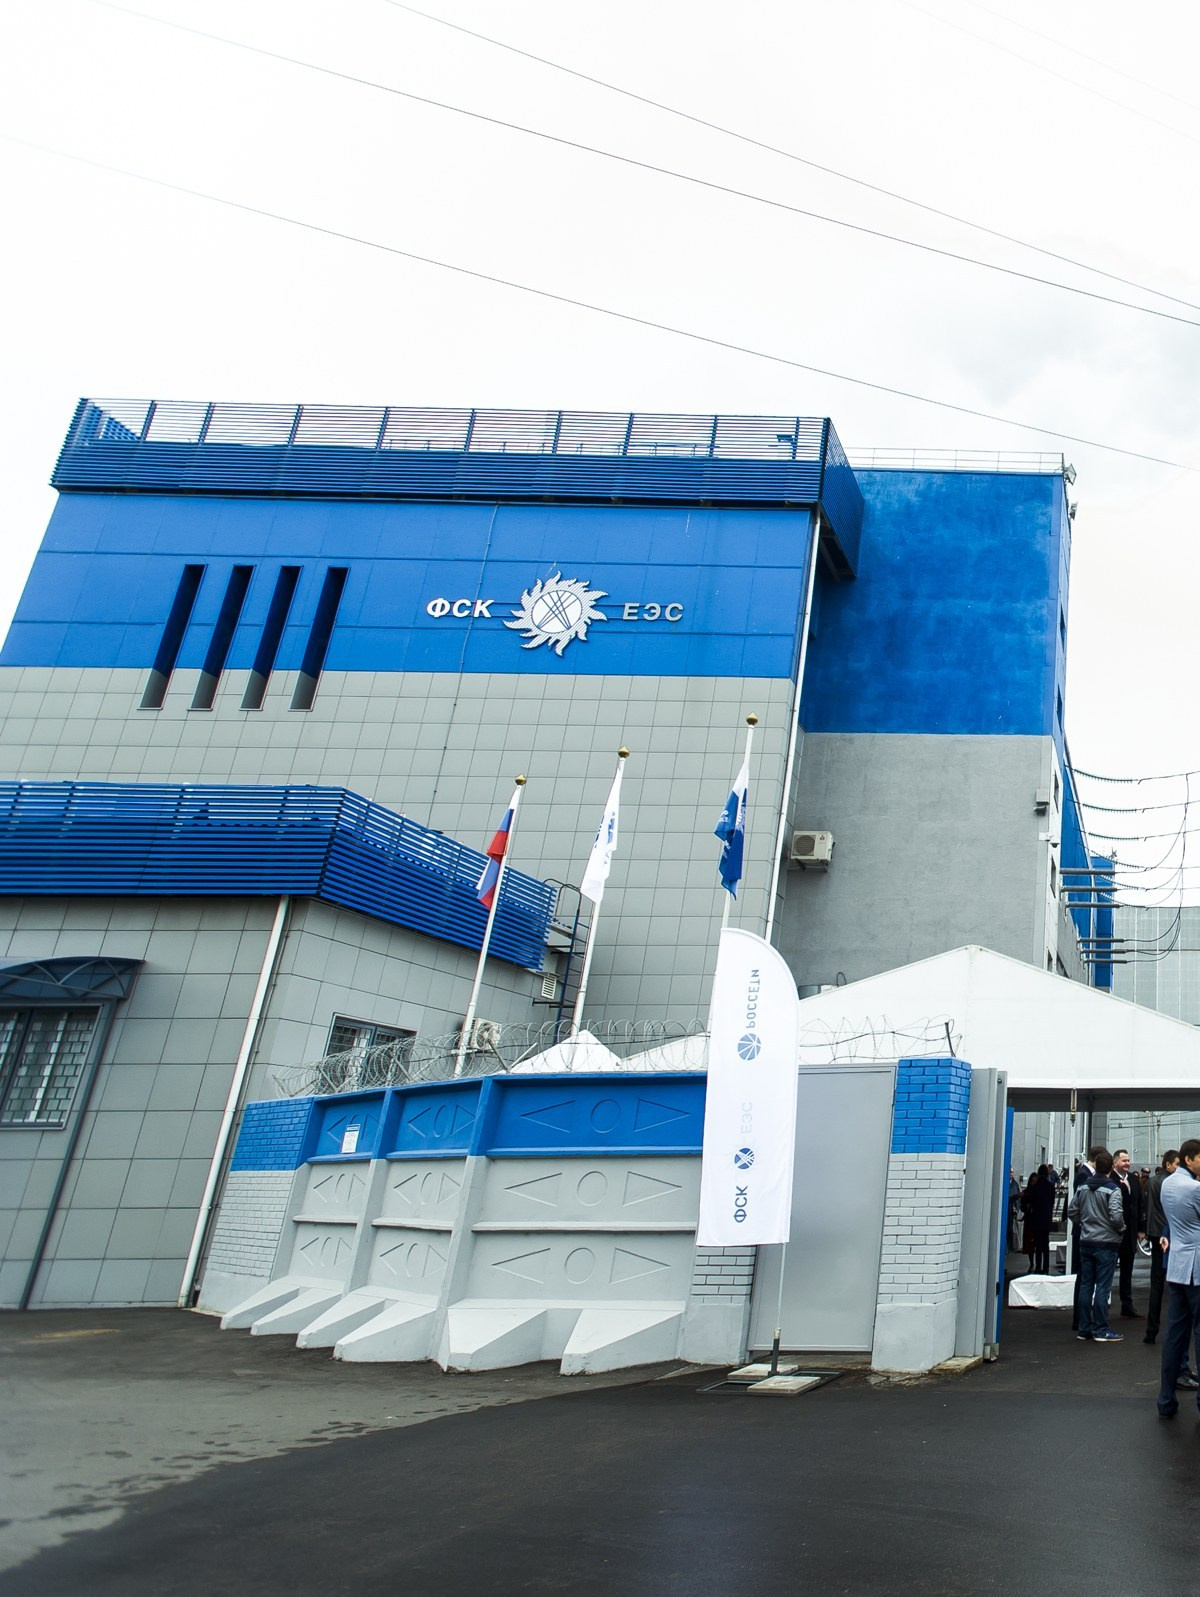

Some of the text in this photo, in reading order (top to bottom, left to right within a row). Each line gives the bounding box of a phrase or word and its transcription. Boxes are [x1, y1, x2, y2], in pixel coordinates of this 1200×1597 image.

[425, 597, 684, 622] ФСК ЕЭС
[733, 1101, 753, 1223] ФСК ЕЭС
